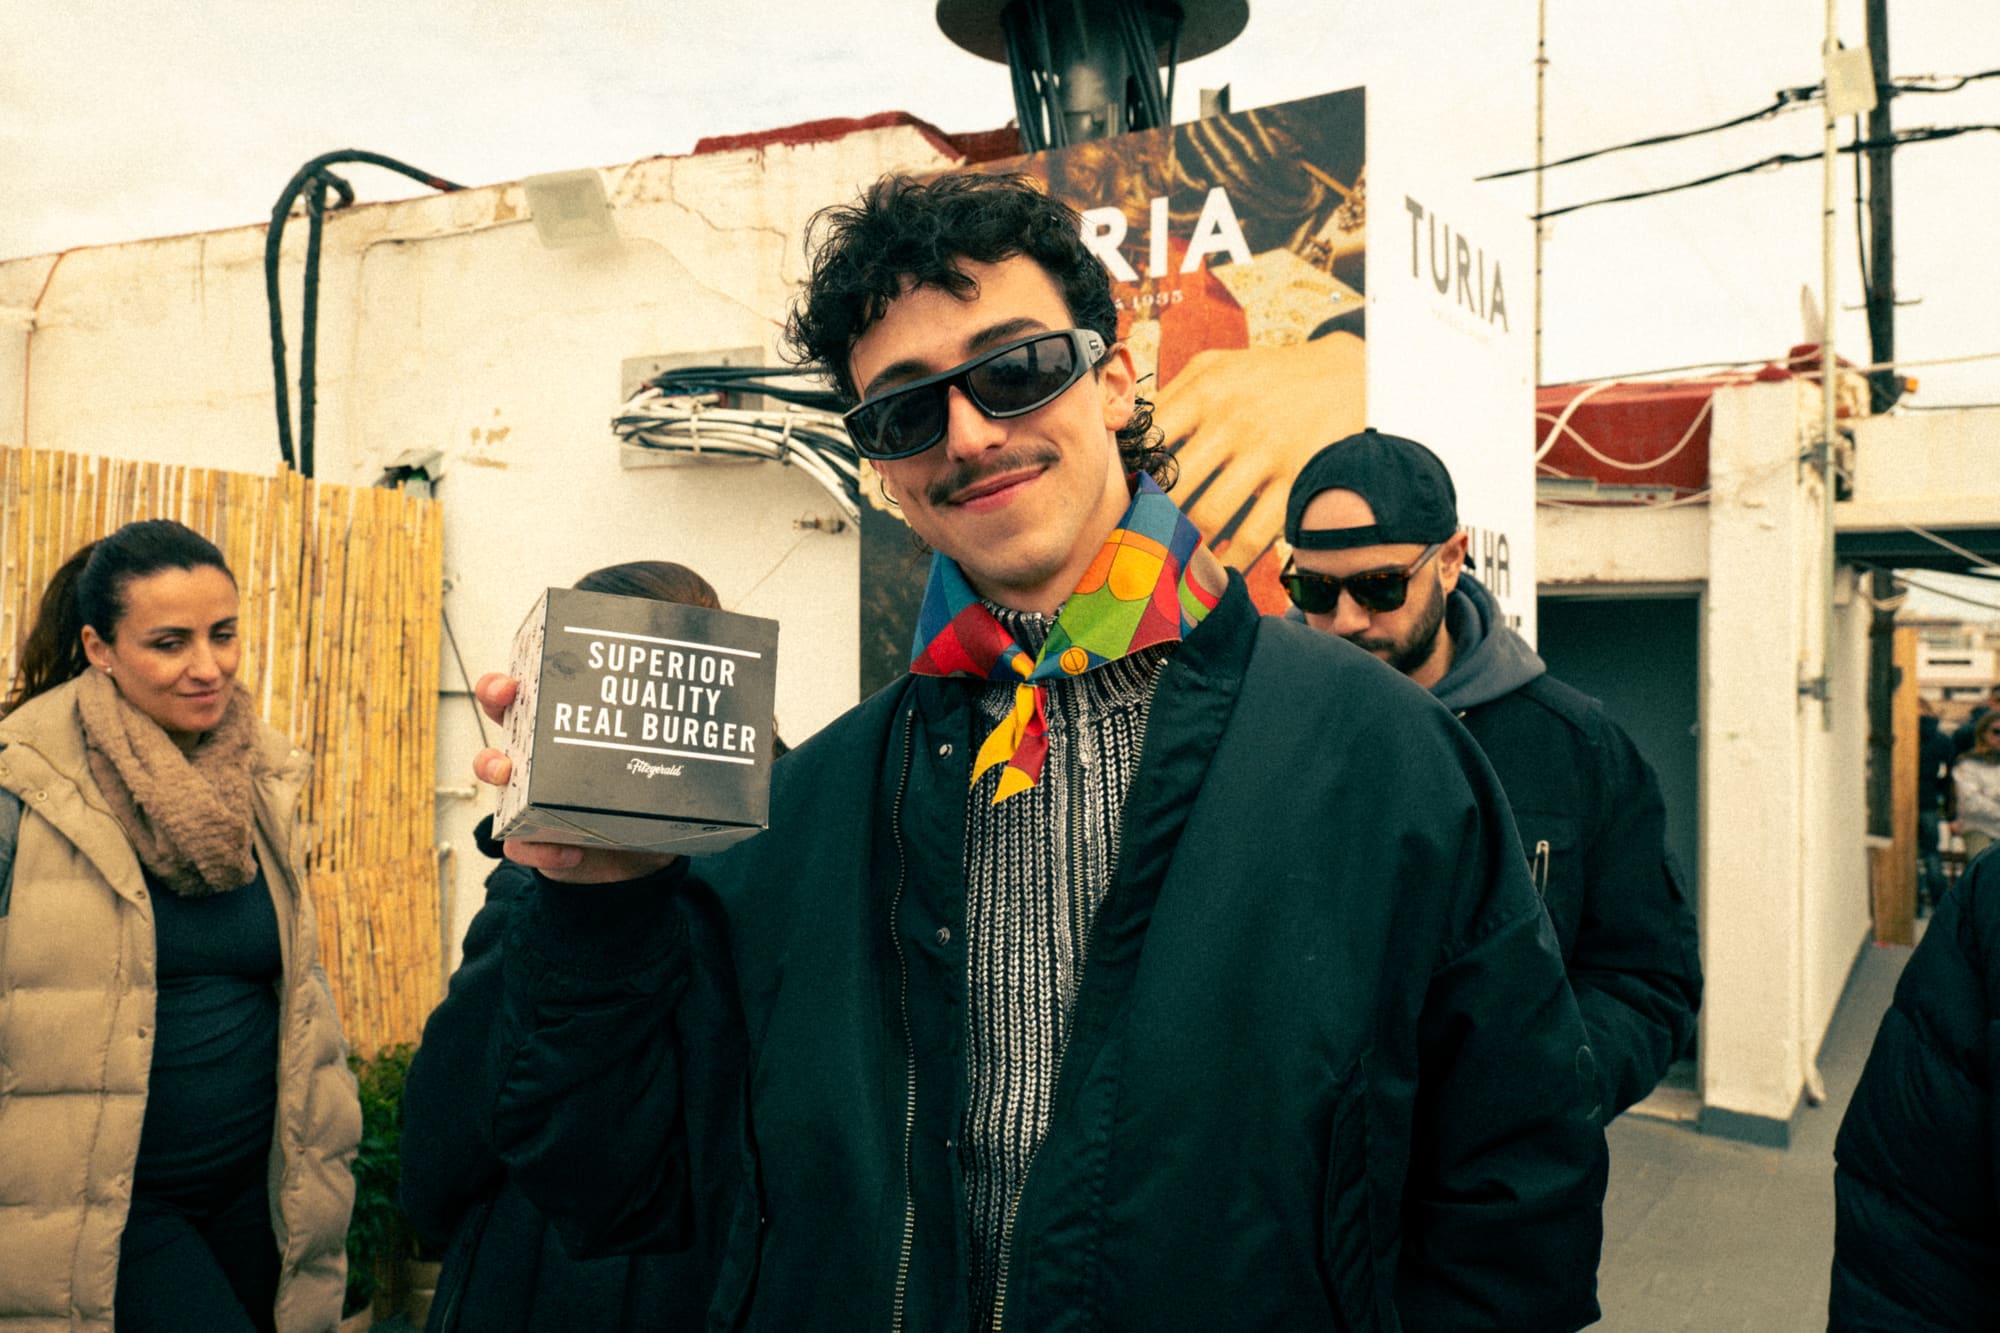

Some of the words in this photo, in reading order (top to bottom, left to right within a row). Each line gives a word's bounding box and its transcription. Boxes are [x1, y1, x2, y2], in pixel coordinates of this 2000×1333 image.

[1405, 194, 1508, 332] TURIA
[588, 641, 735, 687] SUPERIOR
[601, 675, 721, 716] QUALITY
[554, 703, 628, 738] REAL
[642, 713, 756, 753] BURGER
[630, 758, 682, 779] Fitzgerald
